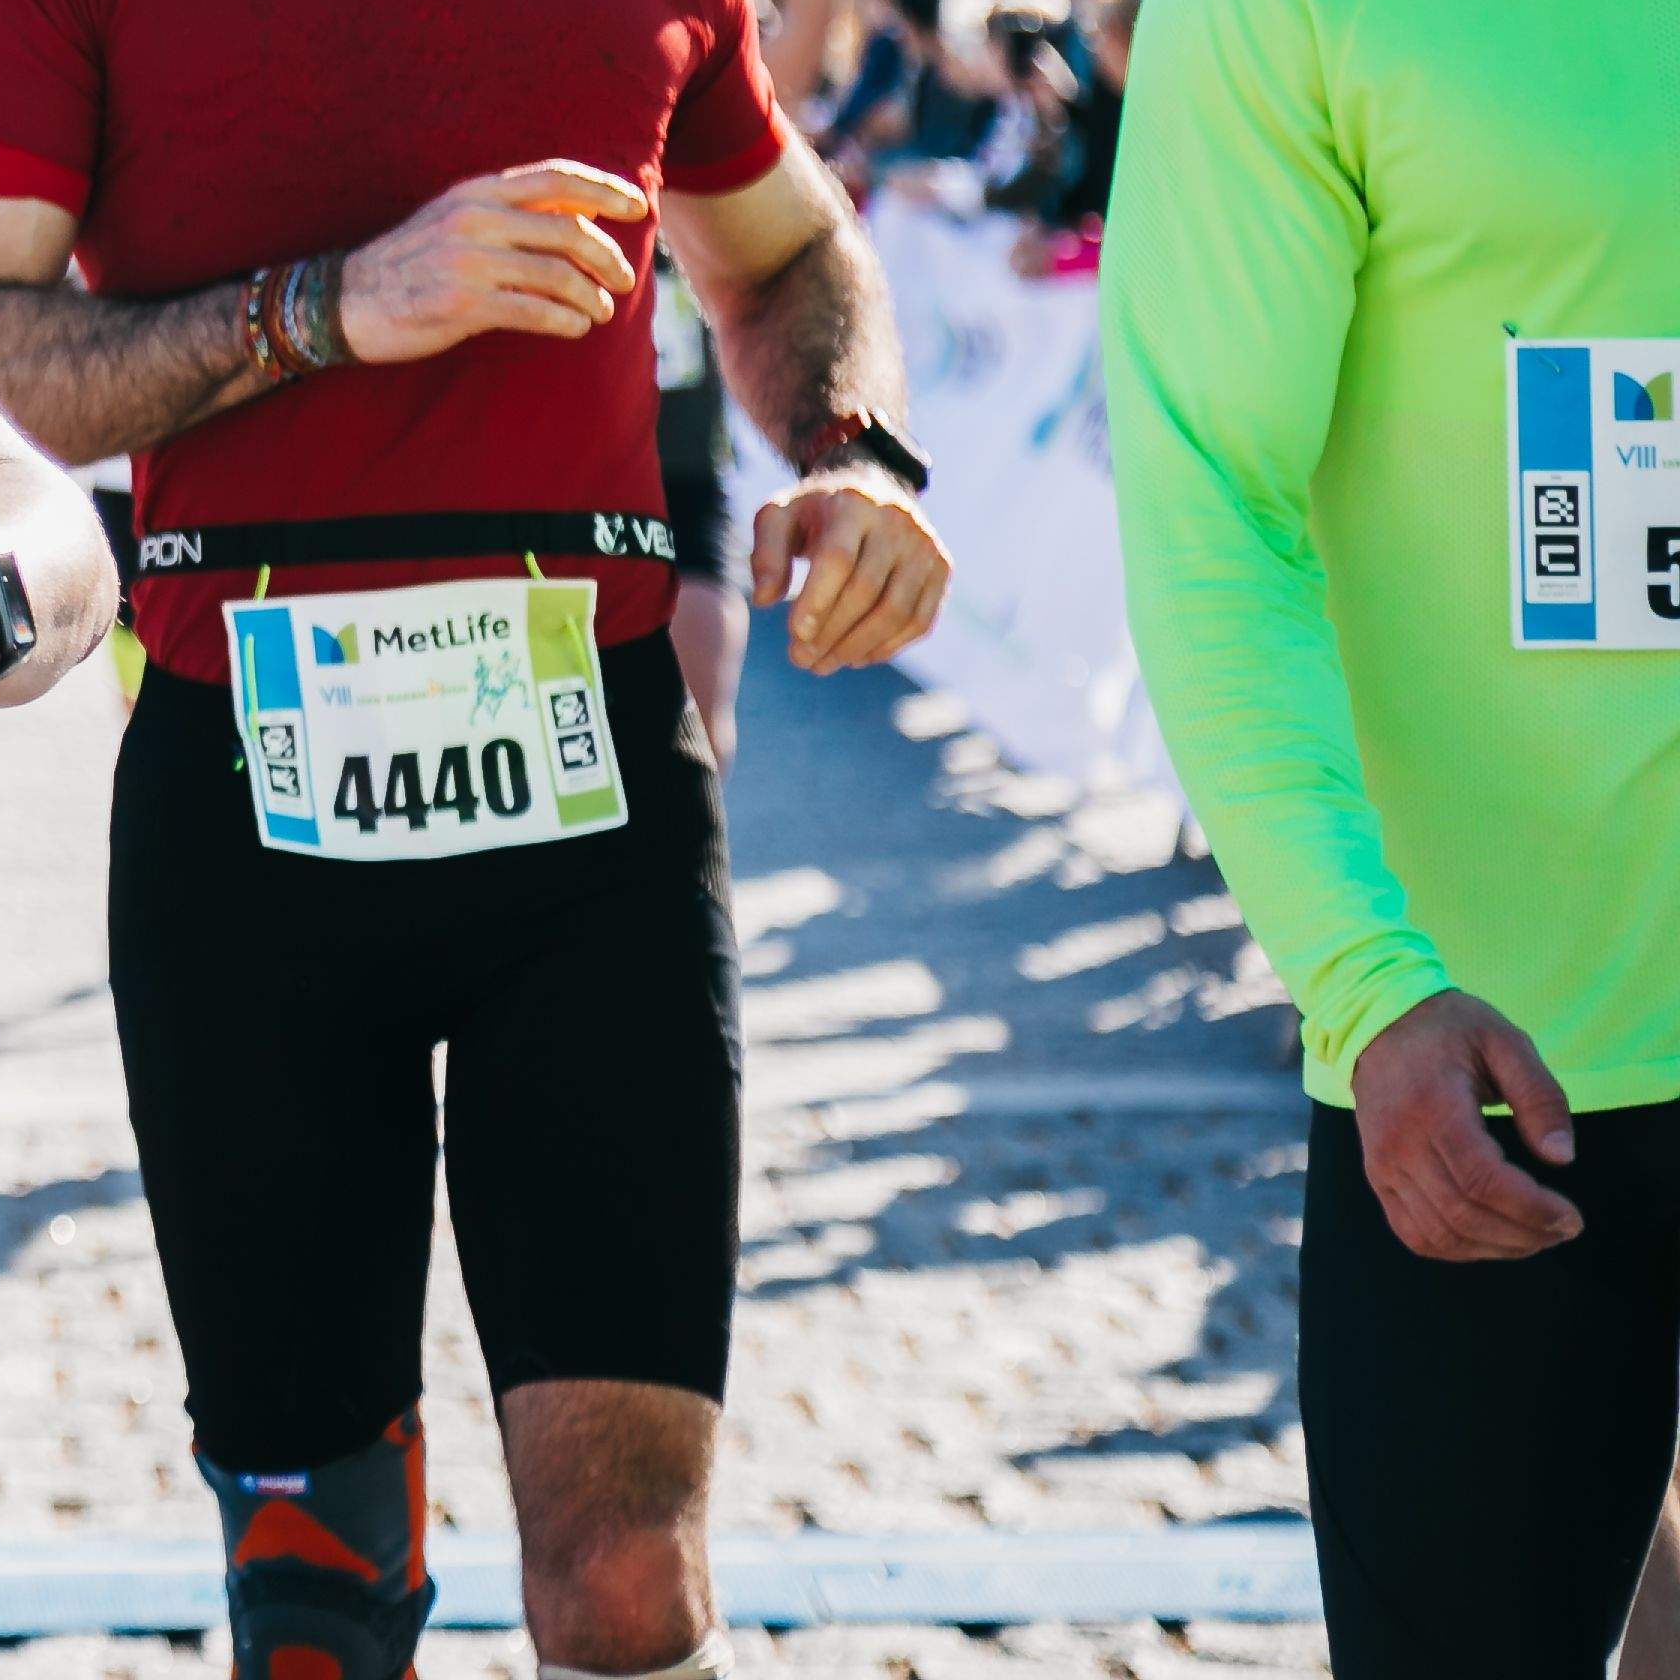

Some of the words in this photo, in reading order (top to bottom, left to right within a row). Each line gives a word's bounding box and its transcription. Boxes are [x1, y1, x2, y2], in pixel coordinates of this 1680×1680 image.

[1616, 444, 1657, 470] VIII
[373, 610, 511, 658] MetLife
[334, 737, 532, 834] 4440
